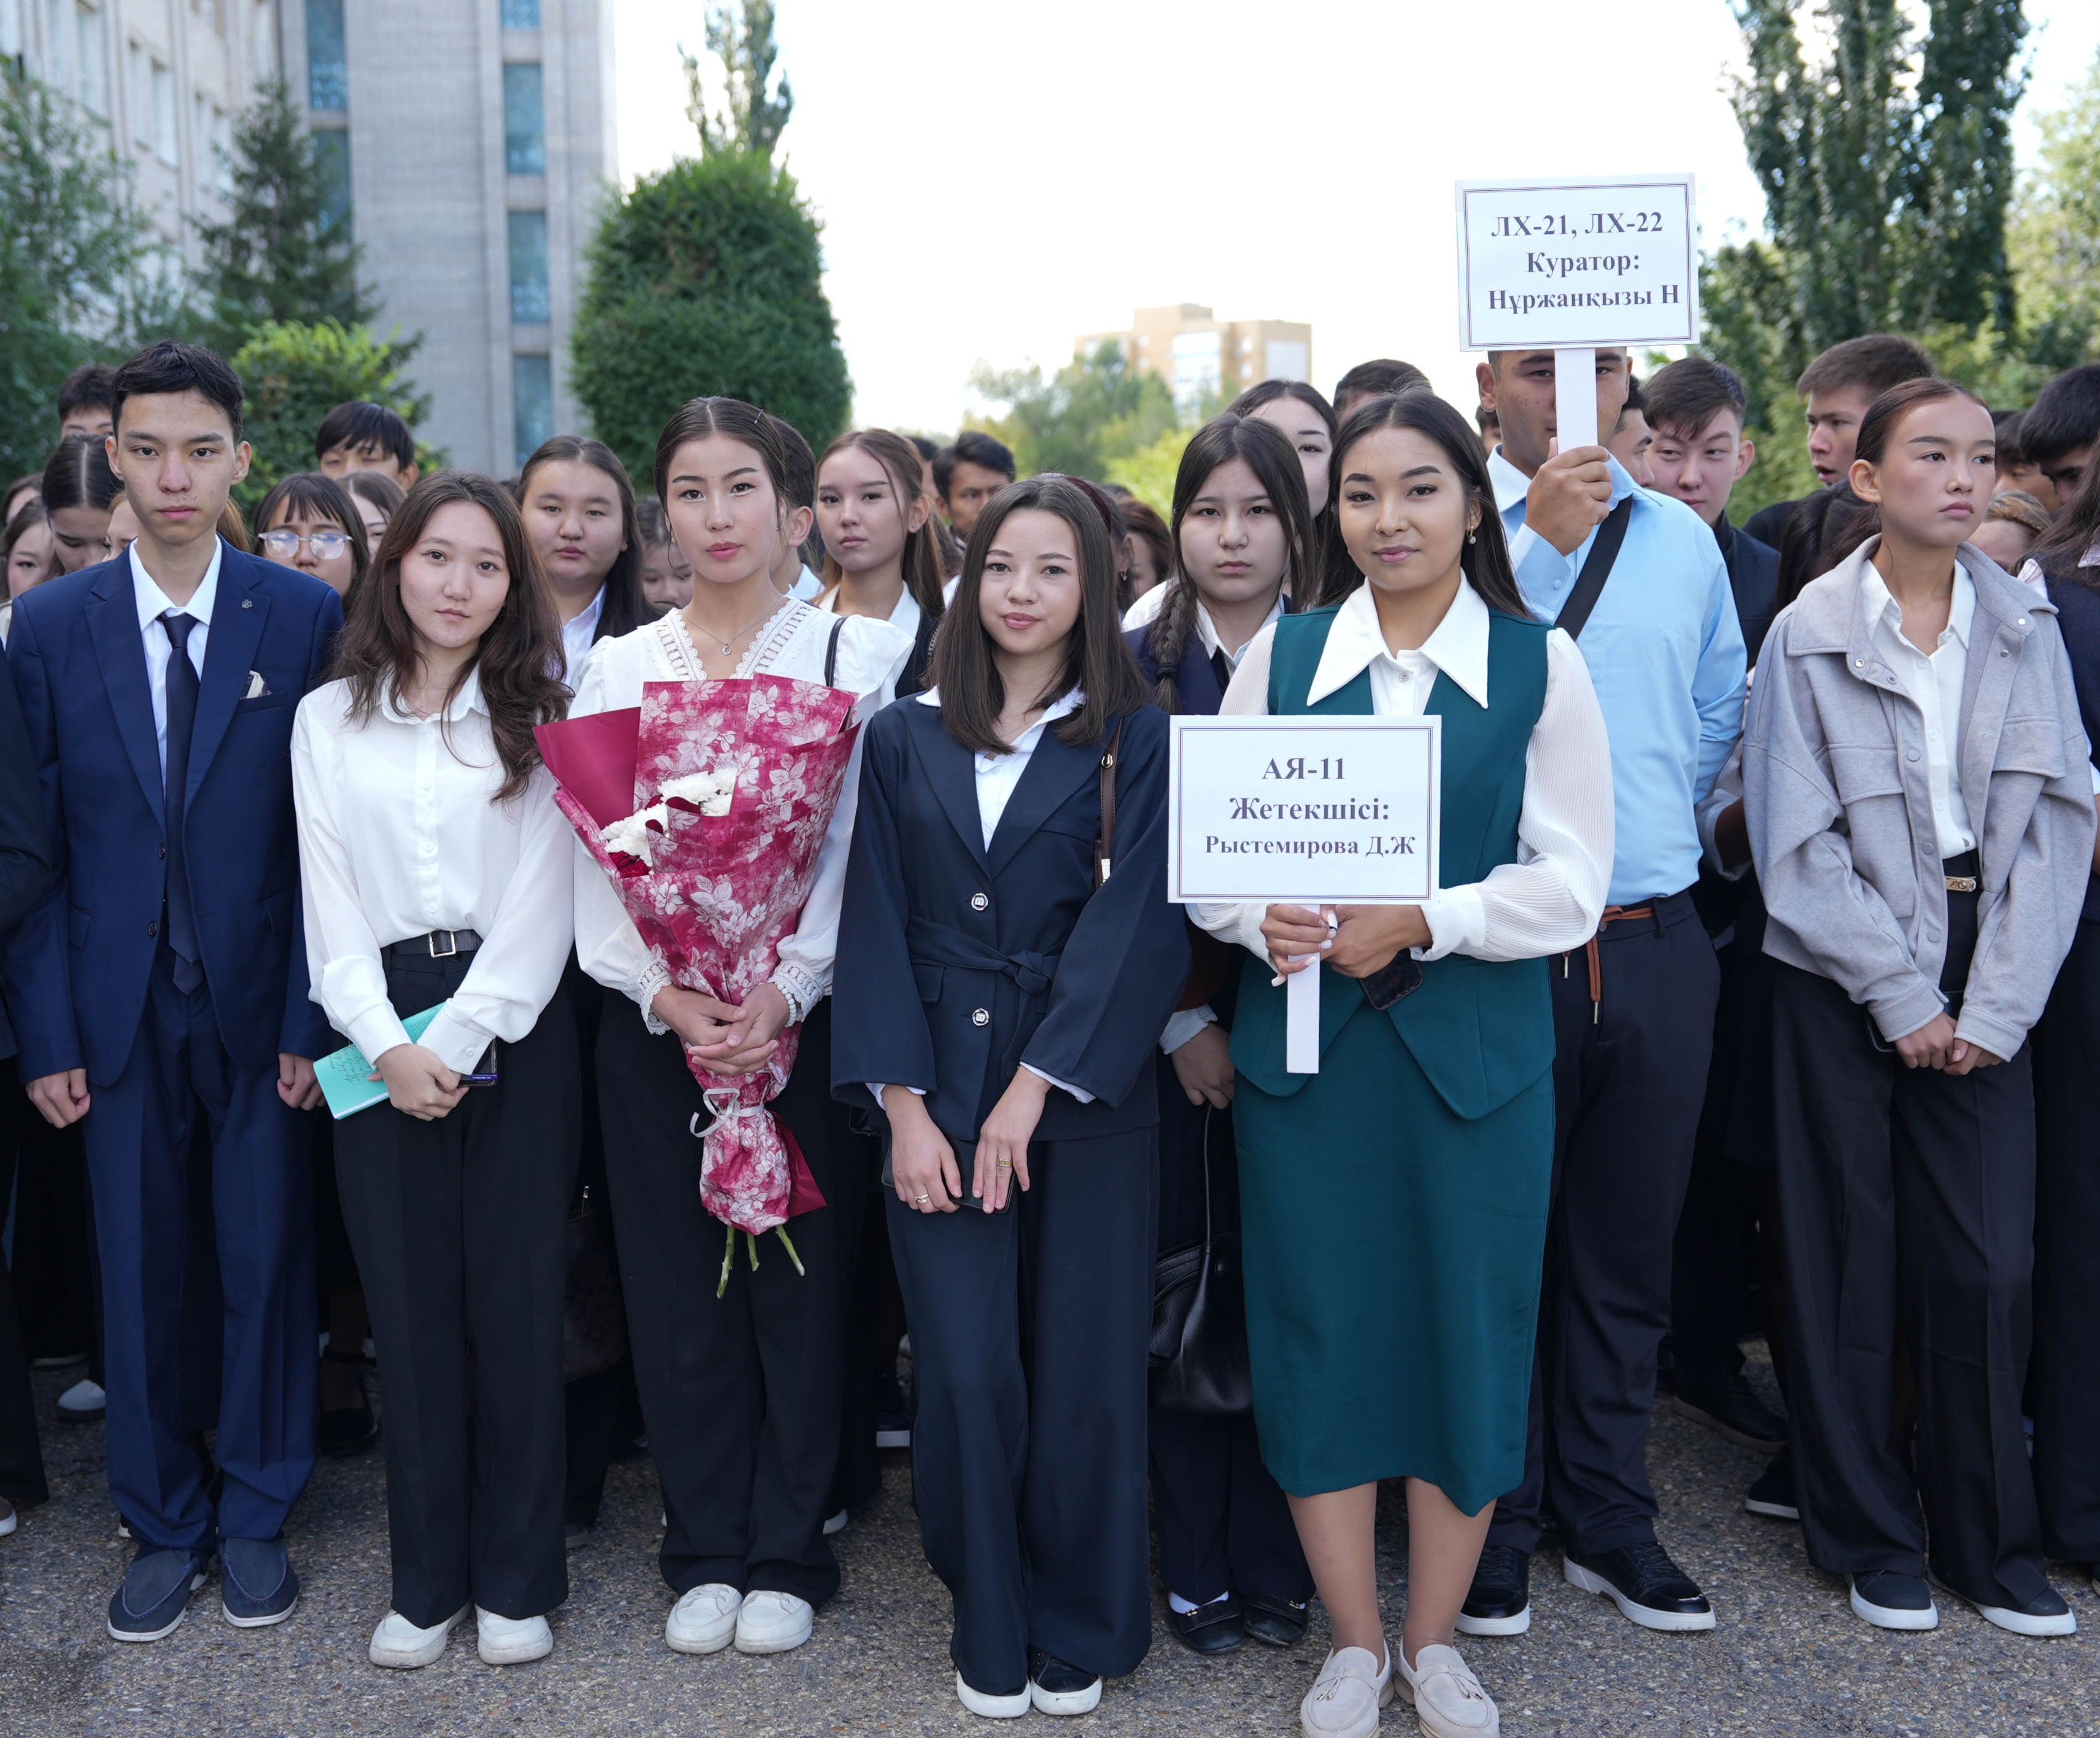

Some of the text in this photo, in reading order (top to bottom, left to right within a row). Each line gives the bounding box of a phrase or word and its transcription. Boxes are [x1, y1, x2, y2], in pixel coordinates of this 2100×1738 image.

[1492, 212, 1662, 238] ЛХ-21, ЛХ-22
[1528, 253, 1638, 277] Куратор:
[1490, 285, 1678, 314] Нұржанқызы Н
[1263, 758, 1343, 779] АЯ-11
[1230, 798, 1388, 819] Жетекшісі:
[1207, 836, 1415, 859] Рыстемирова Д.Ж
